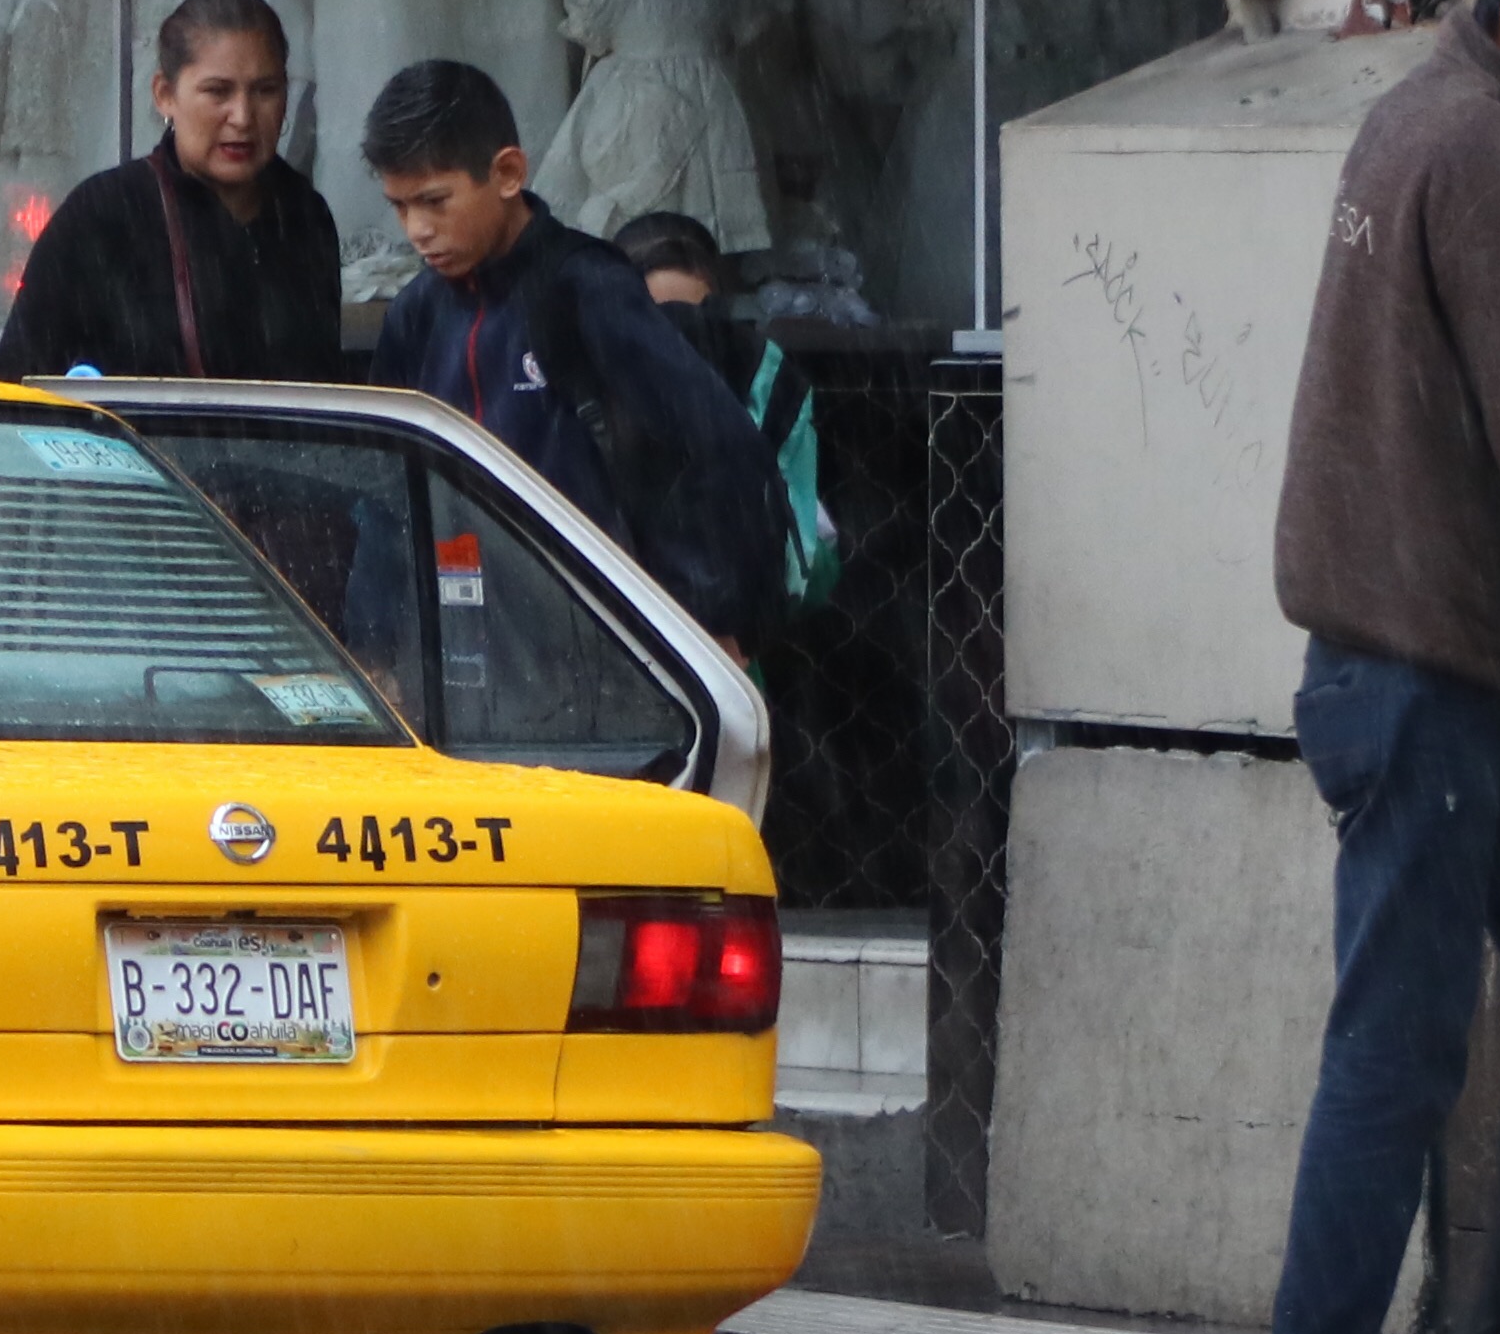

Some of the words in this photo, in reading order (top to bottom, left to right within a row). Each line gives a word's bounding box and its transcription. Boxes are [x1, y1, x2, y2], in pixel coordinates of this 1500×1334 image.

[218, 825, 273, 837] NISSAN
[316, 815, 512, 872] 4413-T
[121, 959, 339, 1020] B-332-DAF
